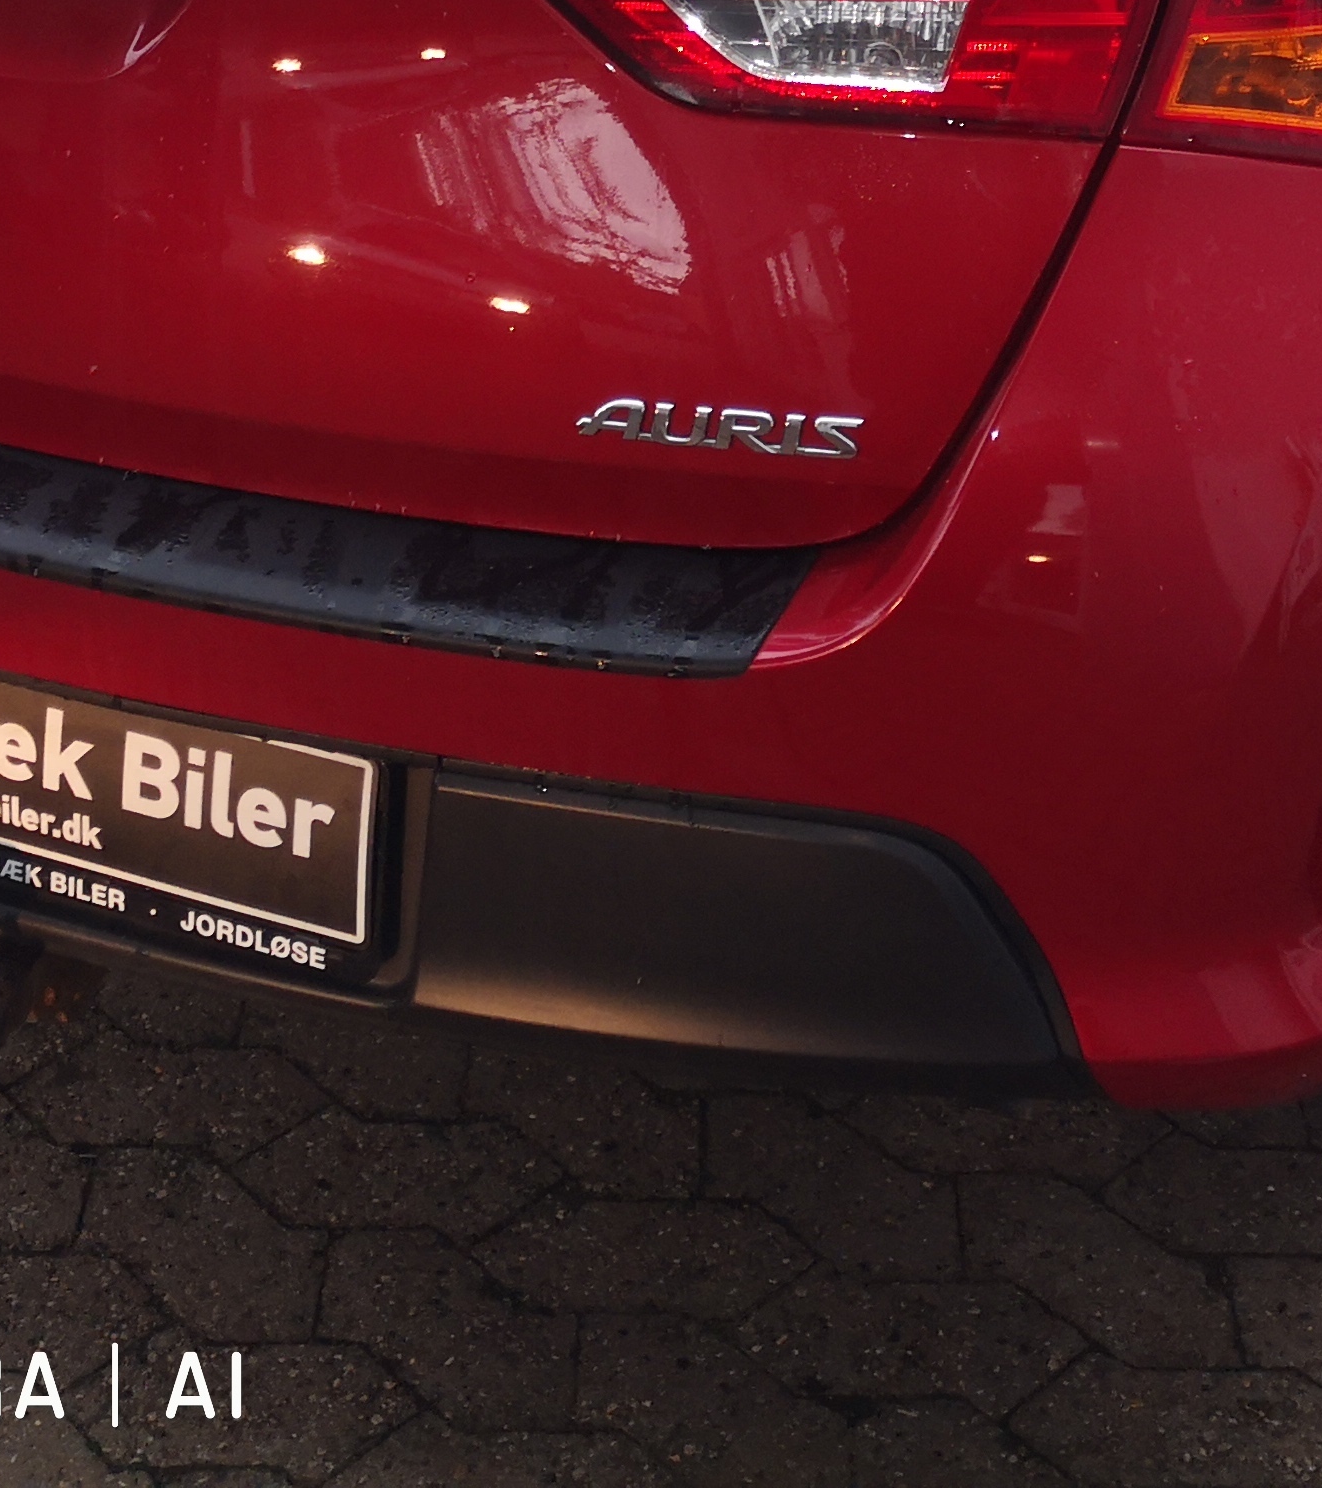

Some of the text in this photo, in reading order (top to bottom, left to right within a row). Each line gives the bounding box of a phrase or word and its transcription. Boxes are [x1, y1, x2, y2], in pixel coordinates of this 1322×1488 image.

[575, 398, 865, 459] AURIS
[121, 730, 336, 859] Biler
[49, 871, 127, 912] BILER
[179, 910, 327, 971] JORDLØSE
